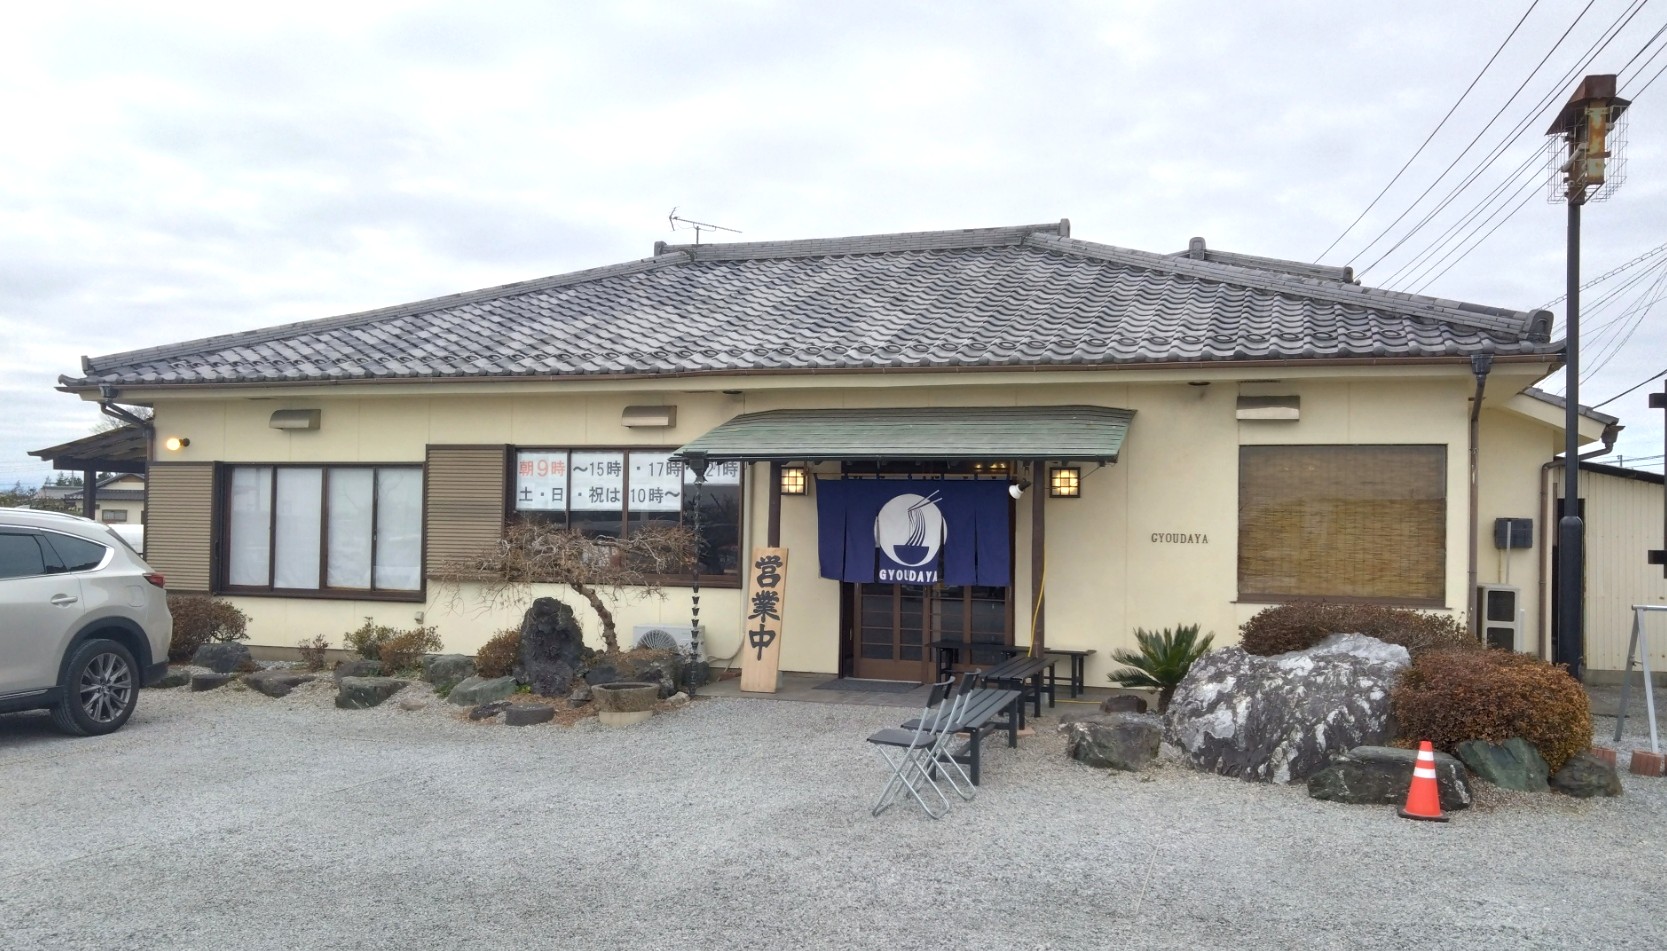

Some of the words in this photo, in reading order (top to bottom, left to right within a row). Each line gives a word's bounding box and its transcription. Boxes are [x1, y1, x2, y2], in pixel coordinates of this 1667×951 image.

[1151, 532, 1209, 544] GYOUDAYA
[747, 555, 783, 661] 営業中
